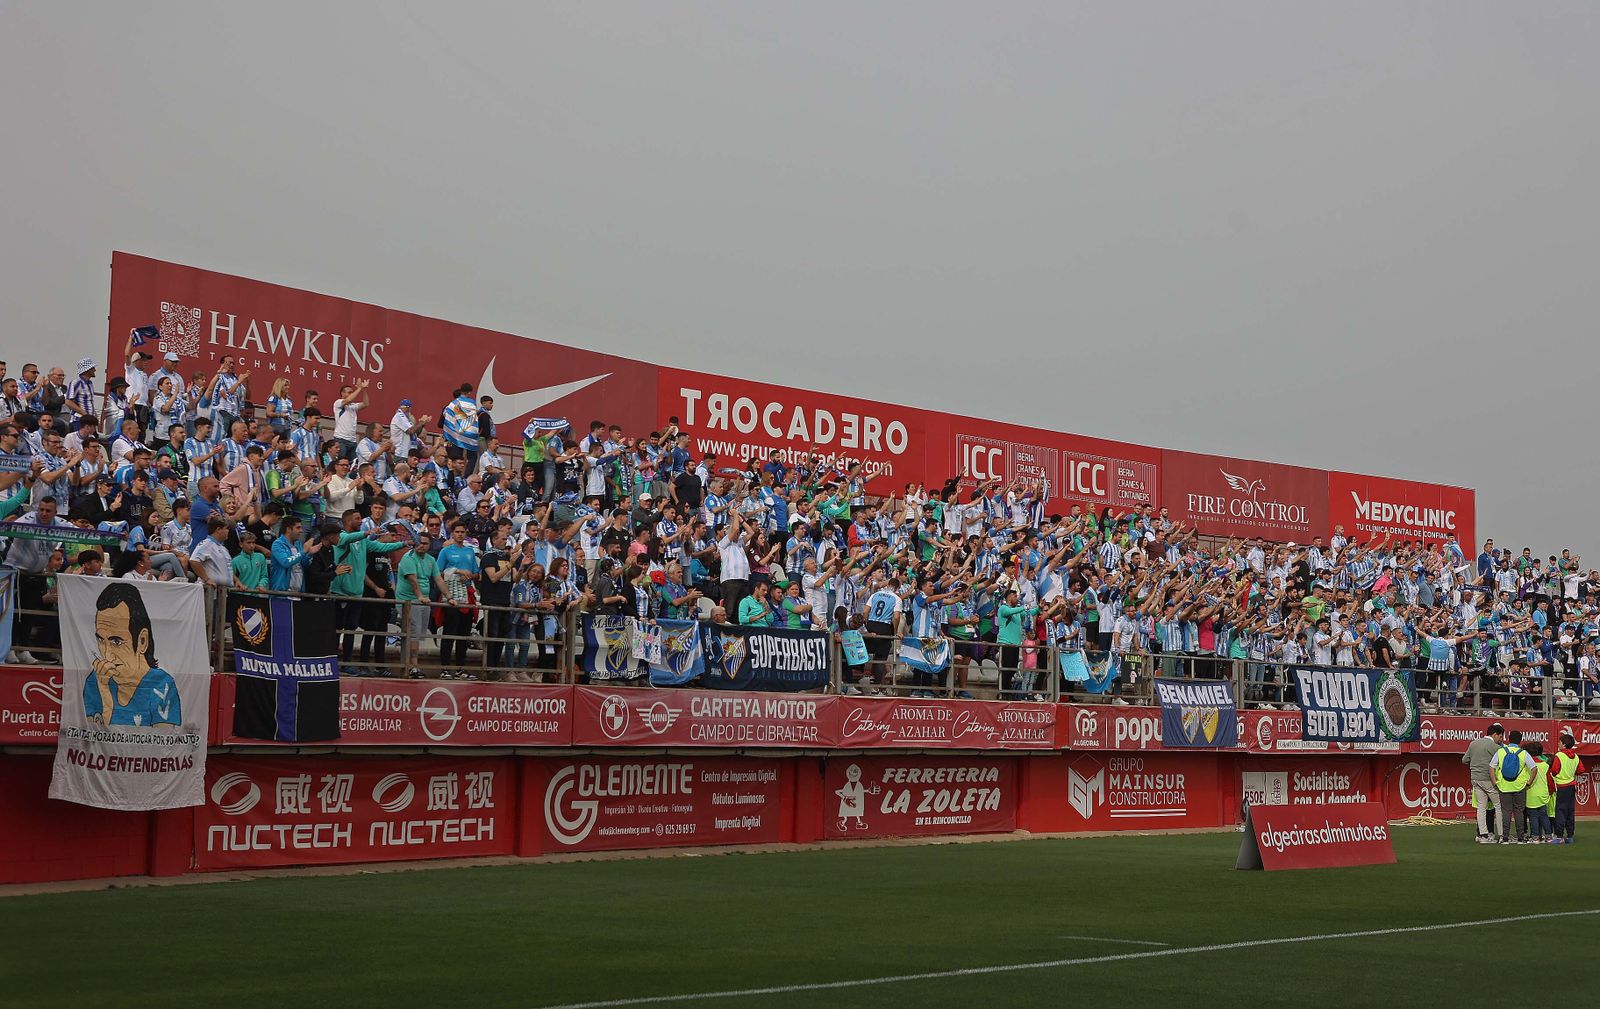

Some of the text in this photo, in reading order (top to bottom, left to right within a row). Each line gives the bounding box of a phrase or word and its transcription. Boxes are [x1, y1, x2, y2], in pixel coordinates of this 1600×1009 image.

[210, 352, 383, 389] TCHMARKETIG
[964, 444, 1002, 482] ICC
[1017, 451, 1034, 462] IBERIA
[1016, 463, 1038, 476] CRANES
[1070, 460, 1105, 495] ICC
[1118, 468, 1134, 477] IBERIA
[1118, 479, 1139, 490] CRANES
[1118, 490, 1149, 502] CONTAINERS
[1187, 493, 1309, 524] FIRE CONTROL
[1351, 491, 1456, 530] MEDYCLINIC
[1356, 523, 1364, 531] TU
[1390, 527, 1412, 536] DENTAL
[1414, 529, 1422, 537] DE
[1424, 530, 1449, 540] CONFIAN
[877, 601, 886, 617] 8
[241, 657, 333, 677] NUEVA MÁLAGA
[1157, 684, 1233, 705] BENAMIEL
[1296, 670, 1371, 709] FONDO
[340, 694, 411, 712] ES MOTOR
[468, 697, 566, 715] GETARES MOTOR
[690, 697, 817, 721] CARTEYA MOTOR
[2, 709, 45, 724] Puerta
[651, 713, 667, 722] MINI
[892, 708, 952, 721] AROMA DE
[997, 711, 1052, 723] AROMA DE
[350, 718, 402, 732] GIBRALTAR
[467, 720, 559, 734] CAMPO DE GIBRALTAR
[843, 708, 896, 738] Catering
[952, 710, 999, 738] Catering
[1308, 710, 1376, 738] SUR 1904
[19, 729, 42, 737] Centro
[117, 734, 125, 743] DE
[153, 735, 166, 745] POR
[690, 723, 818, 743] CAMPO DE GIBRALTAR
[898, 725, 946, 739] AZAHAR
[1002, 727, 1044, 739] AZAHAR
[1440, 730, 1483, 741] HISPAMAROC
[67, 748, 193, 773] NO LO ENTENDERIAS
[1109, 758, 1144, 771] GRUPO
[578, 764, 693, 797] CLEMENTE
[701, 769, 776, 784] Centro de Impresión Digital
[882, 767, 999, 784] FERRETERIA
[1109, 774, 1185, 790] MAINSUR
[1294, 771, 1350, 791] Socialistas
[275, 774, 354, 814] 威视
[427, 772, 494, 810] 威视
[712, 792, 765, 805] Rótulos Luminosos
[1109, 791, 1186, 806] CONSTRUCTORA
[1245, 791, 1264, 804] PSOE
[880, 787, 1001, 814] LA ZOLETA
[714, 815, 761, 831] Imprenta Digital
[925, 817, 931, 825] EL
[932, 816, 972, 825] RINCONCILLO
[207, 823, 353, 851] NUCTECH
[369, 817, 495, 847] NUCTECH
[665, 825, 674, 835] 625
[690, 824, 697, 834] 57
[1261, 820, 1387, 852] algecirasalminuto.es
